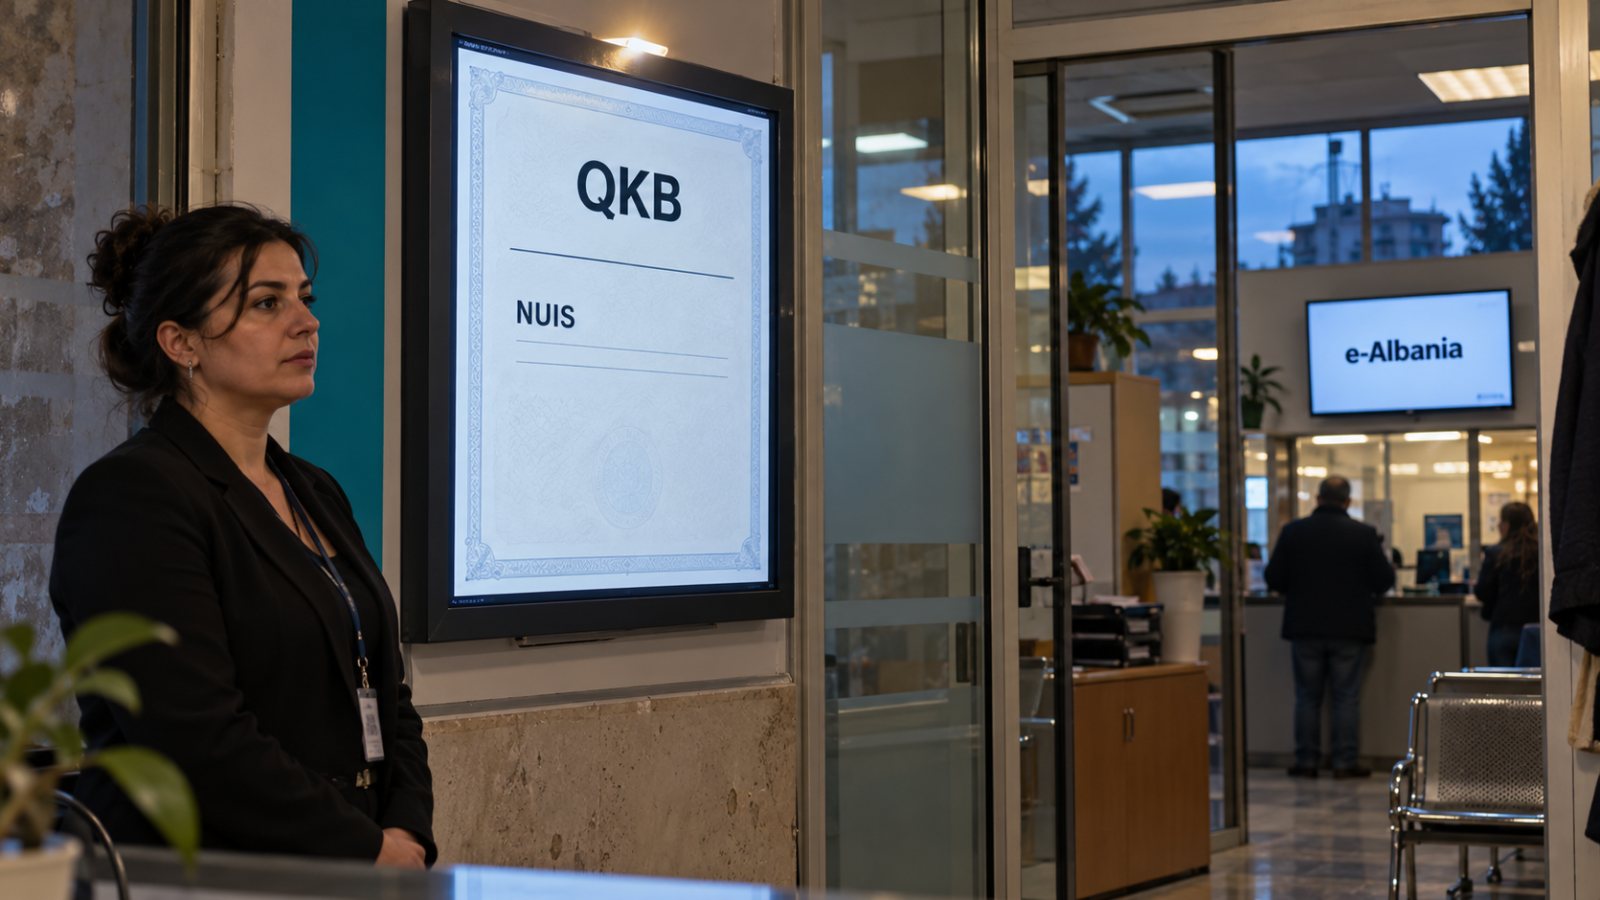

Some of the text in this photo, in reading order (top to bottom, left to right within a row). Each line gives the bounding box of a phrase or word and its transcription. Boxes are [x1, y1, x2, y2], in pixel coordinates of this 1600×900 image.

[577, 160, 682, 222] QKB
[517, 300, 575, 328] NUIS
[1345, 337, 1463, 364] e-Albania
